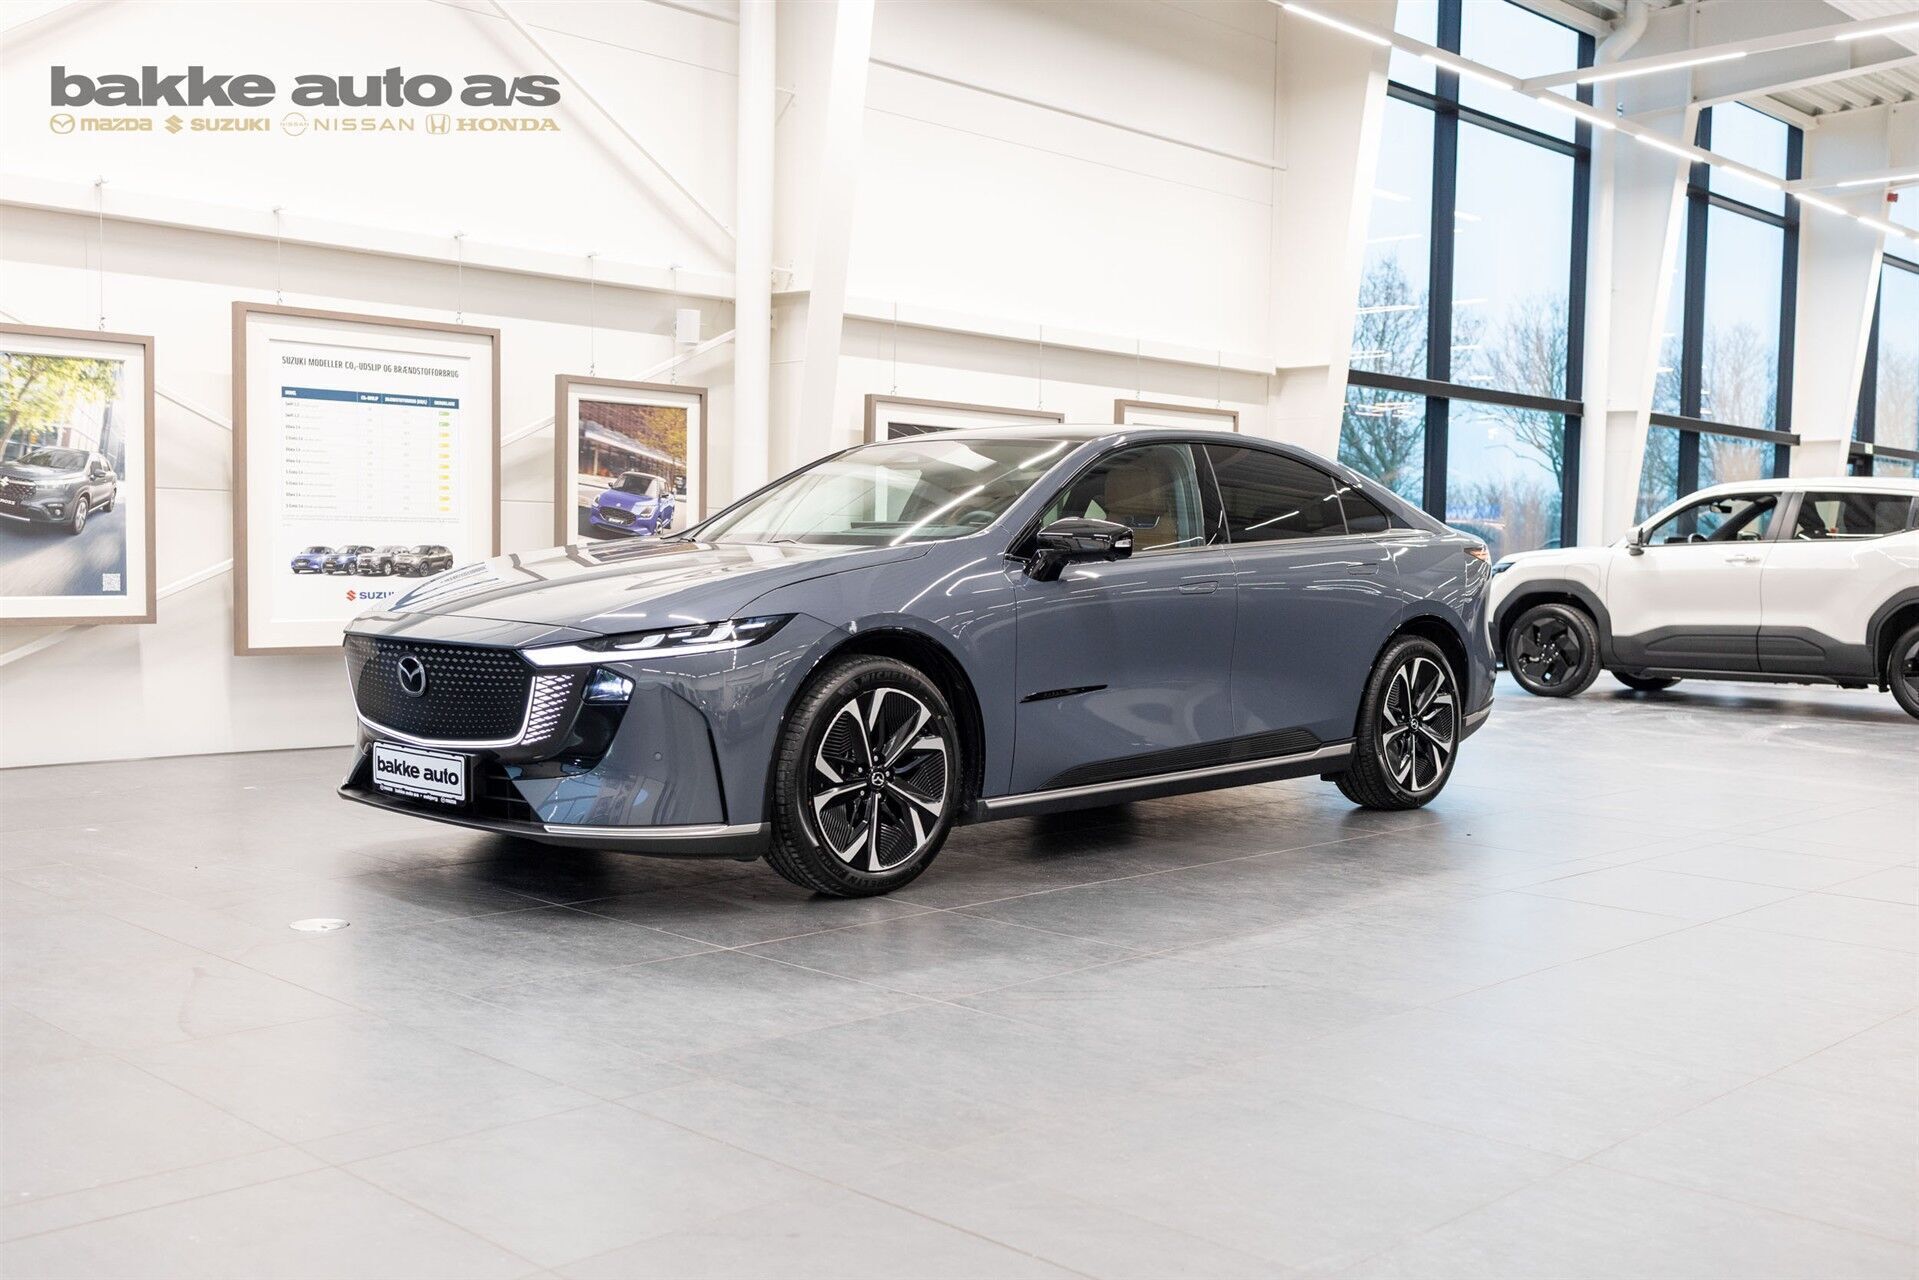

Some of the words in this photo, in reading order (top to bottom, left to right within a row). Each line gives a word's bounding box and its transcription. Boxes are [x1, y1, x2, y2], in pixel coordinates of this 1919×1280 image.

[282, 356, 307, 366] SUZUKI
[308, 358, 343, 369] MODELLER
[383, 364, 392, 373] OG
[359, 591, 395, 600] SUZU
[377, 755, 420, 779] bakke
[423, 767, 460, 786] auto
